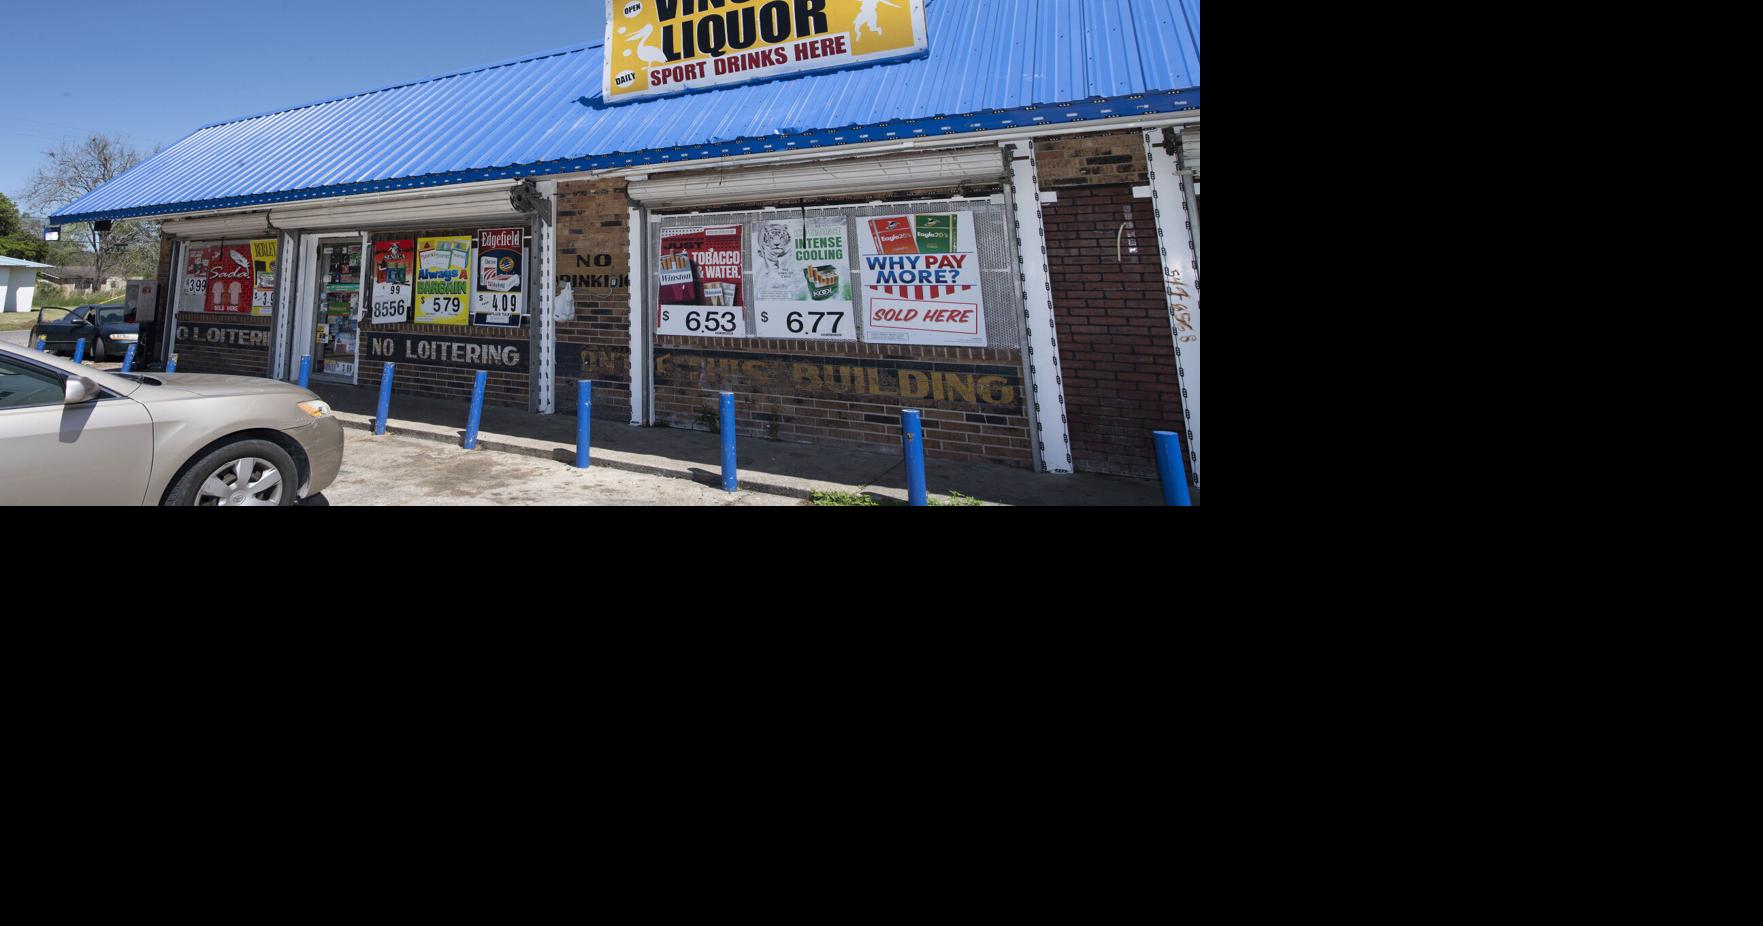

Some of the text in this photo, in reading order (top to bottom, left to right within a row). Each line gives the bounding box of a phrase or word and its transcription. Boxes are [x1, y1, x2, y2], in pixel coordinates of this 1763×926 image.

[624, 3, 641, 15] OPEN
[661, 0, 829, 62] LIQUOR
[650, 35, 847, 86] SPORT DRINKS HERE
[615, 72, 636, 86] DAILY
[482, 231, 520, 248] Edgefield
[794, 236, 843, 249] INTENSE
[576, 253, 612, 268] NO
[692, 250, 740, 266] TOBACCO
[795, 248, 844, 261] COOLING
[866, 255, 967, 270] WHY PAY
[418, 268, 468, 282] Always A
[661, 274, 691, 283] Winston
[705, 265, 742, 279] WATER.
[876, 269, 960, 284] MORE?
[417, 280, 467, 295] BARGAIN
[373, 300, 405, 318] 8556
[492, 293, 517, 313] 4.09
[662, 310, 737, 334] $ 6.53
[760, 311, 845, 335] $ 6.77
[873, 308, 974, 323] SOLD HERE
[177, 325, 271, 346] O LOITERI
[372, 336, 520, 366] NO LOITERING
[792, 361, 1015, 405] BUILDING
